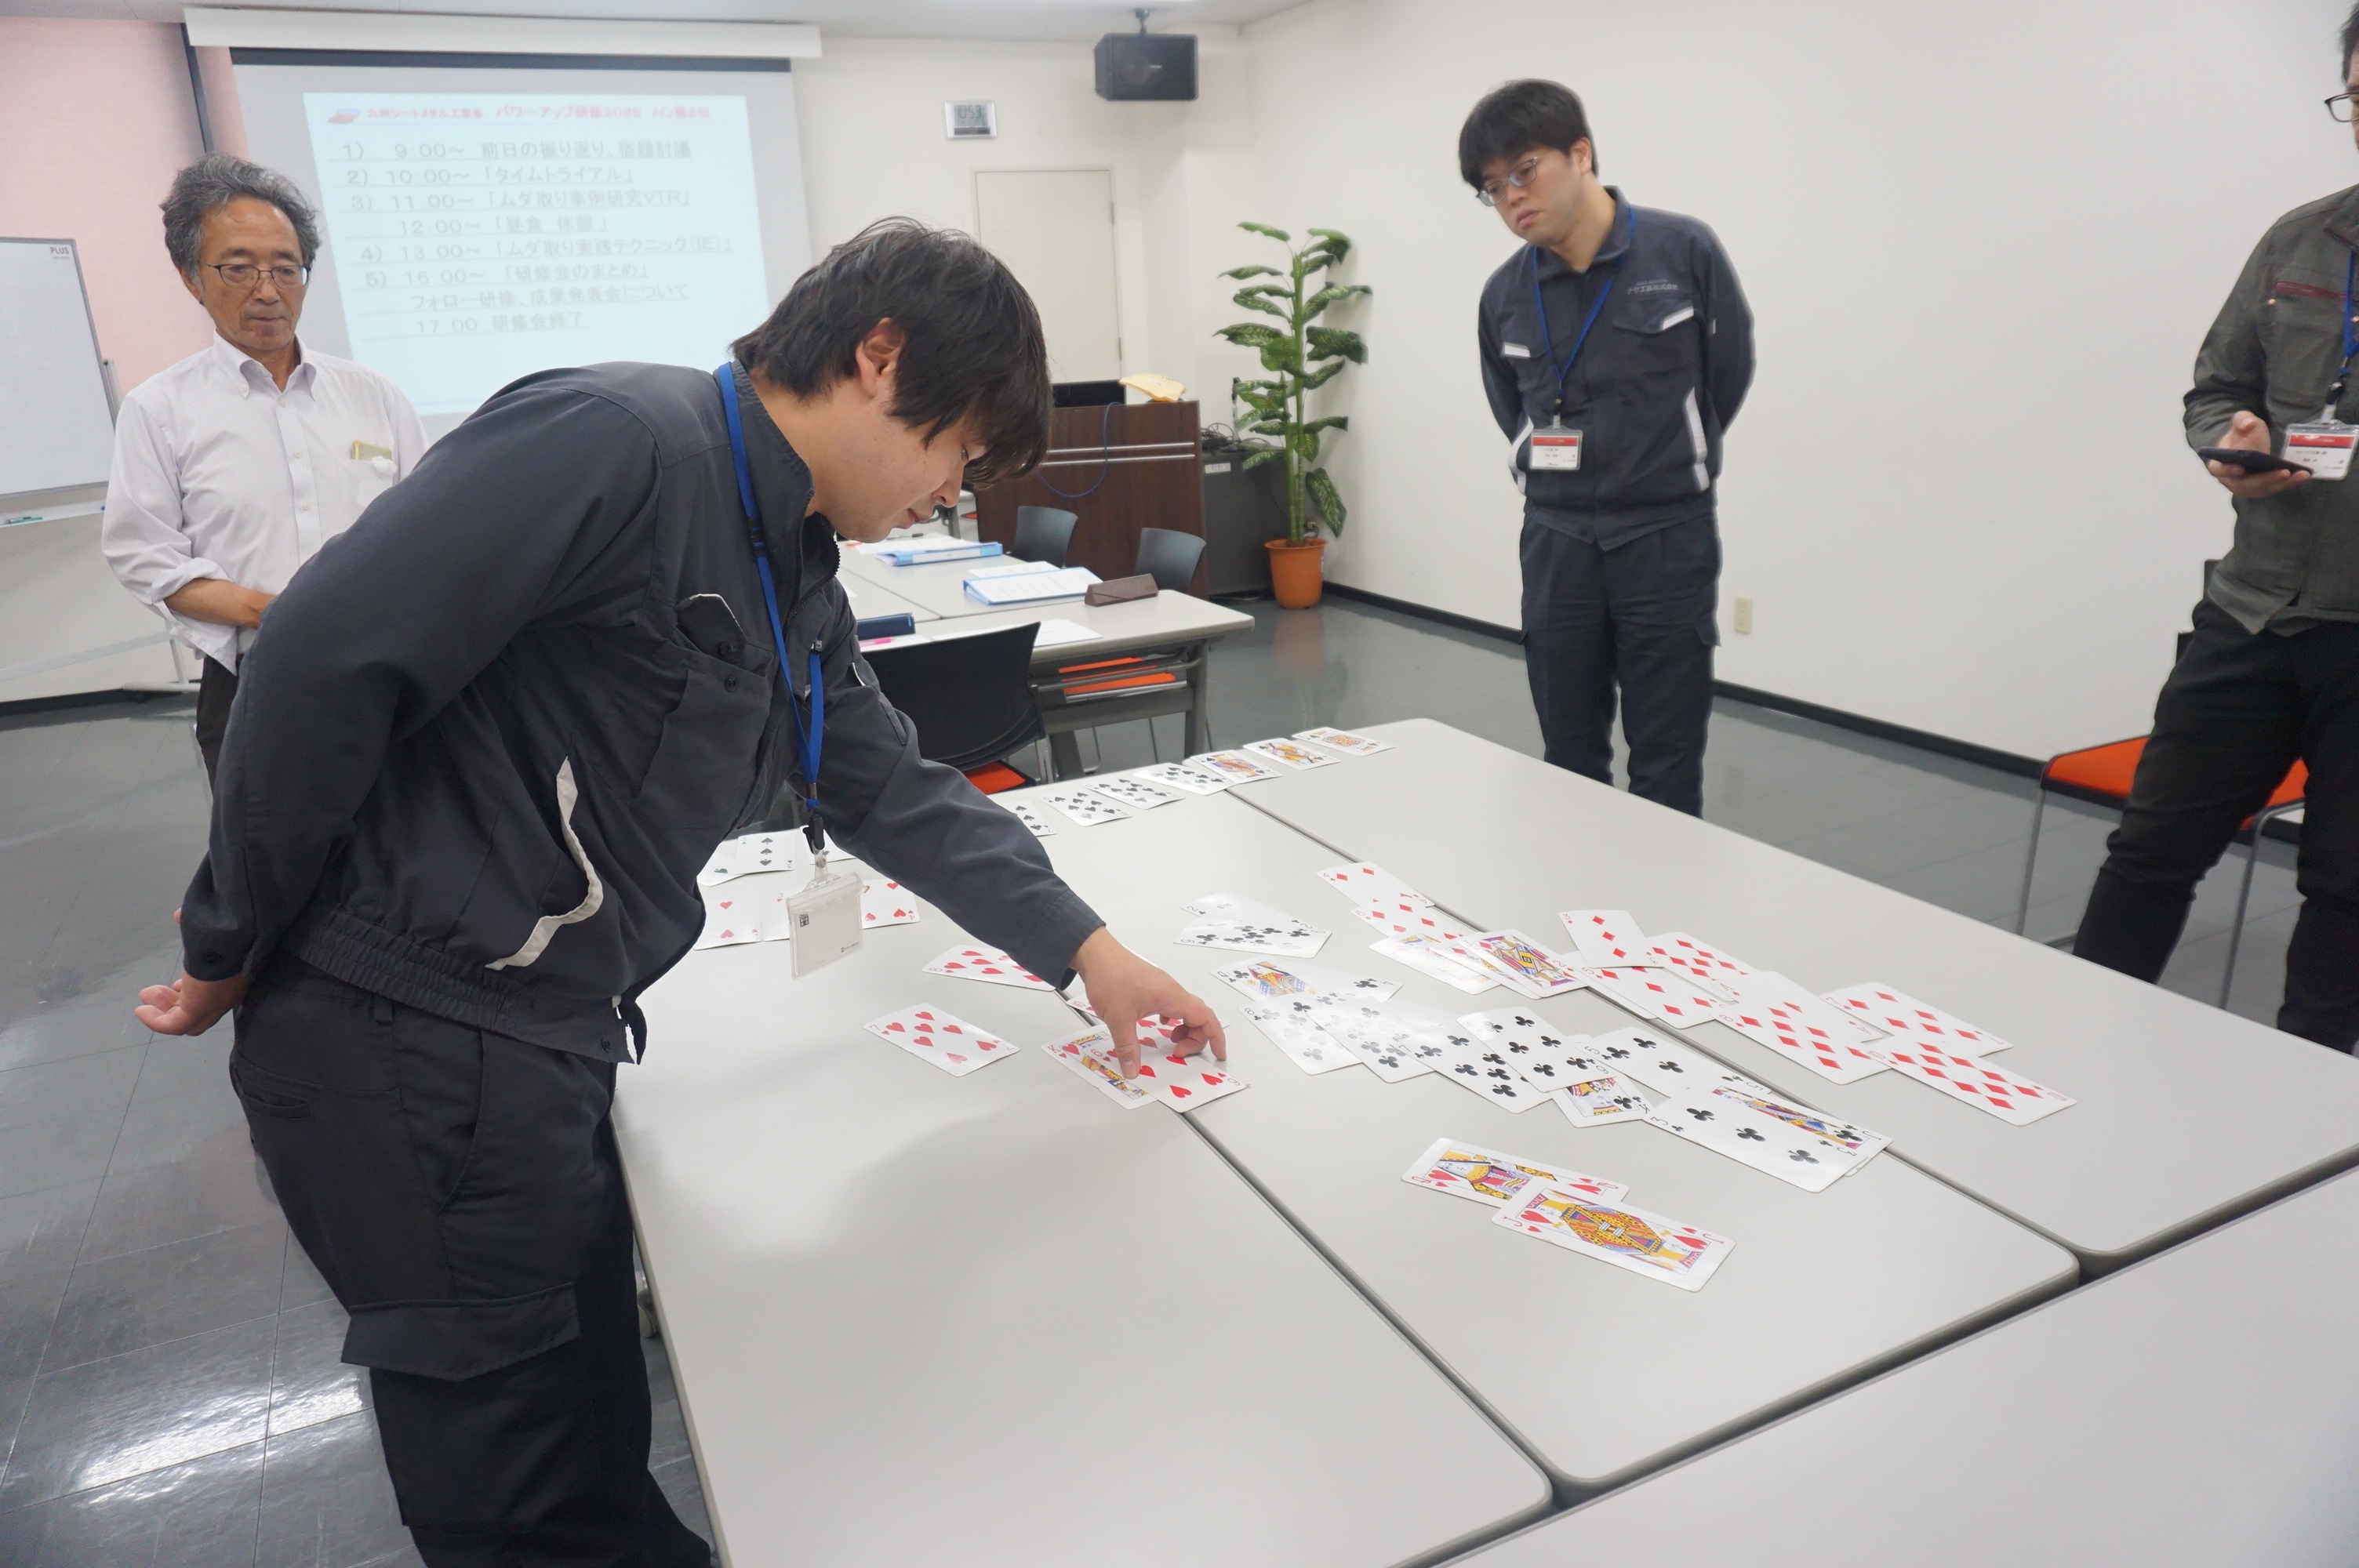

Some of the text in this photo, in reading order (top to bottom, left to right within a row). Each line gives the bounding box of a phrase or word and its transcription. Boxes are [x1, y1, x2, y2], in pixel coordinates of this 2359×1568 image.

[50, 246, 70, 255] PLUS
[1581, 966, 1595, 975] 5
[1719, 1013, 1734, 1022] 8
[1048, 1045, 1061, 1054] K
[1398, 1044, 1412, 1053] 7
[1584, 1046, 1601, 1055] 5
[1649, 1116, 1670, 1126] 3
[1503, 1214, 1524, 1228] J
